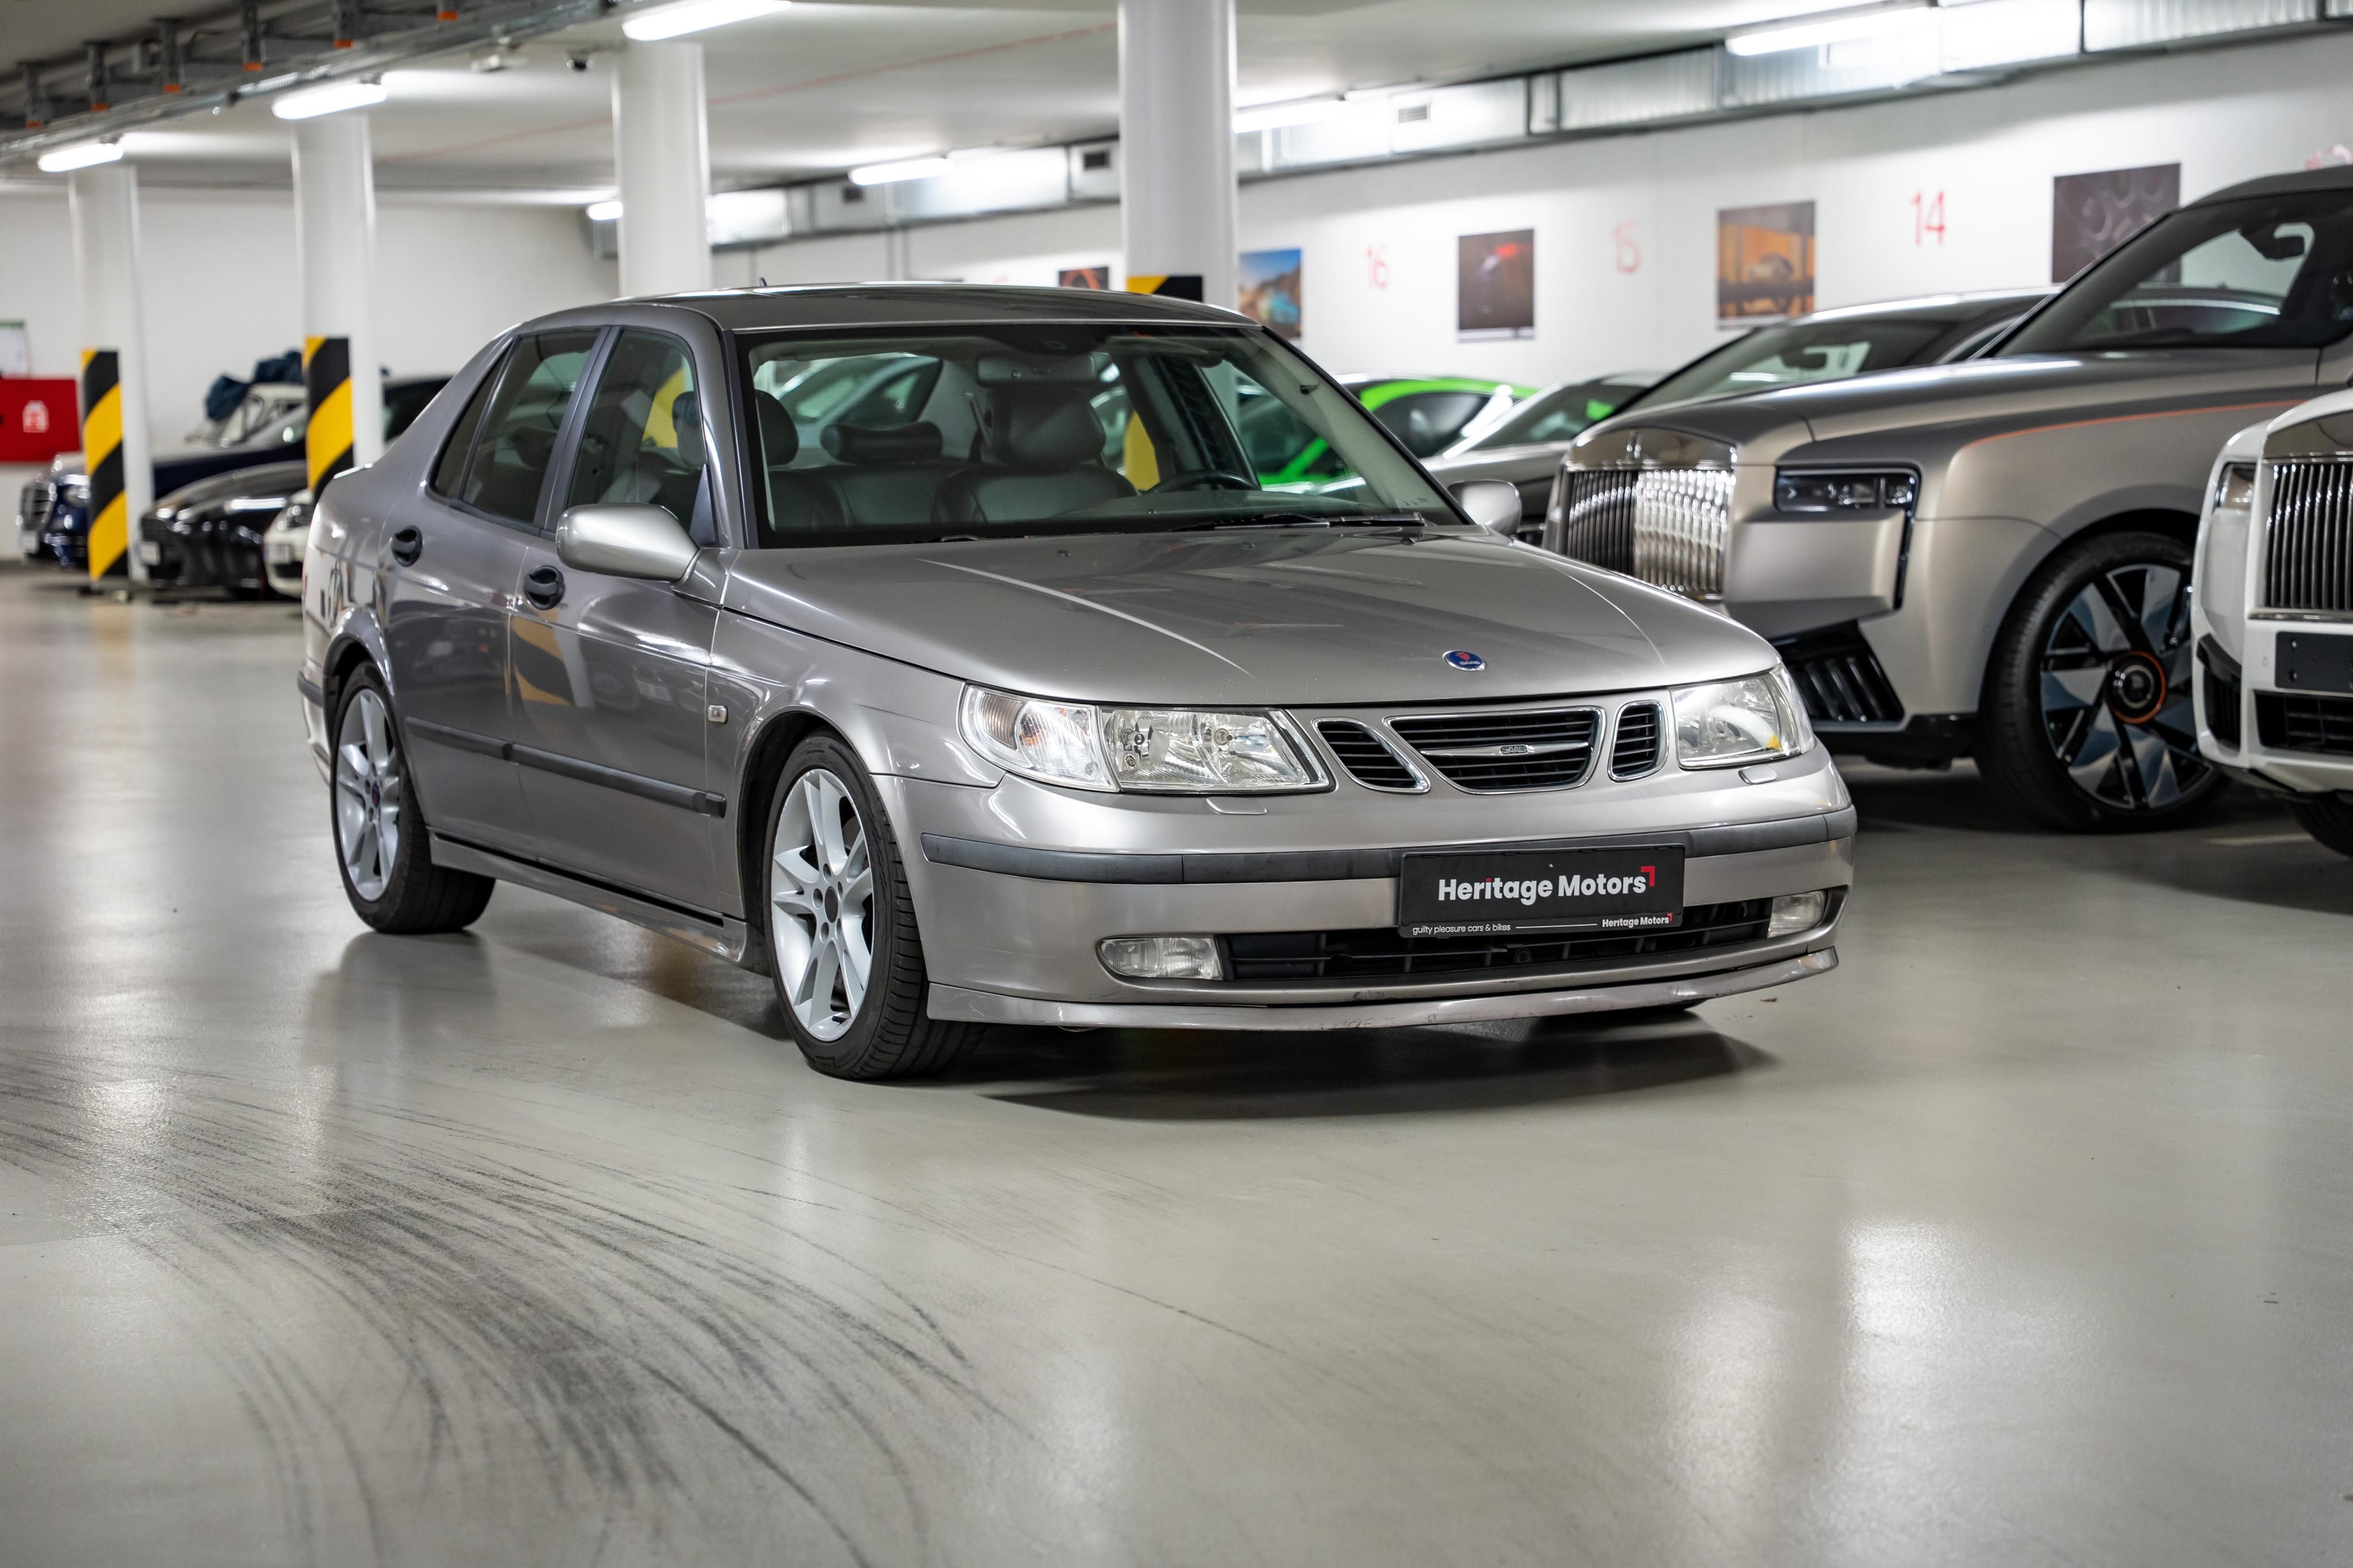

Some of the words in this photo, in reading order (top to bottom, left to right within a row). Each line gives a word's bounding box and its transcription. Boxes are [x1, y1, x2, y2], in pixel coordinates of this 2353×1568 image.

[1908, 190, 1946, 245] 14
[1365, 243, 1390, 289] 16
[1611, 221, 1641, 274] 15
[1438, 878, 1553, 905] Heritage
[1558, 874, 1646, 897] Motors
[1413, 926, 1432, 935] guilty
[1434, 925, 1465, 934] pleasure
[1602, 918, 1639, 928] Heritage
[1640, 917, 1669, 925] Motors
